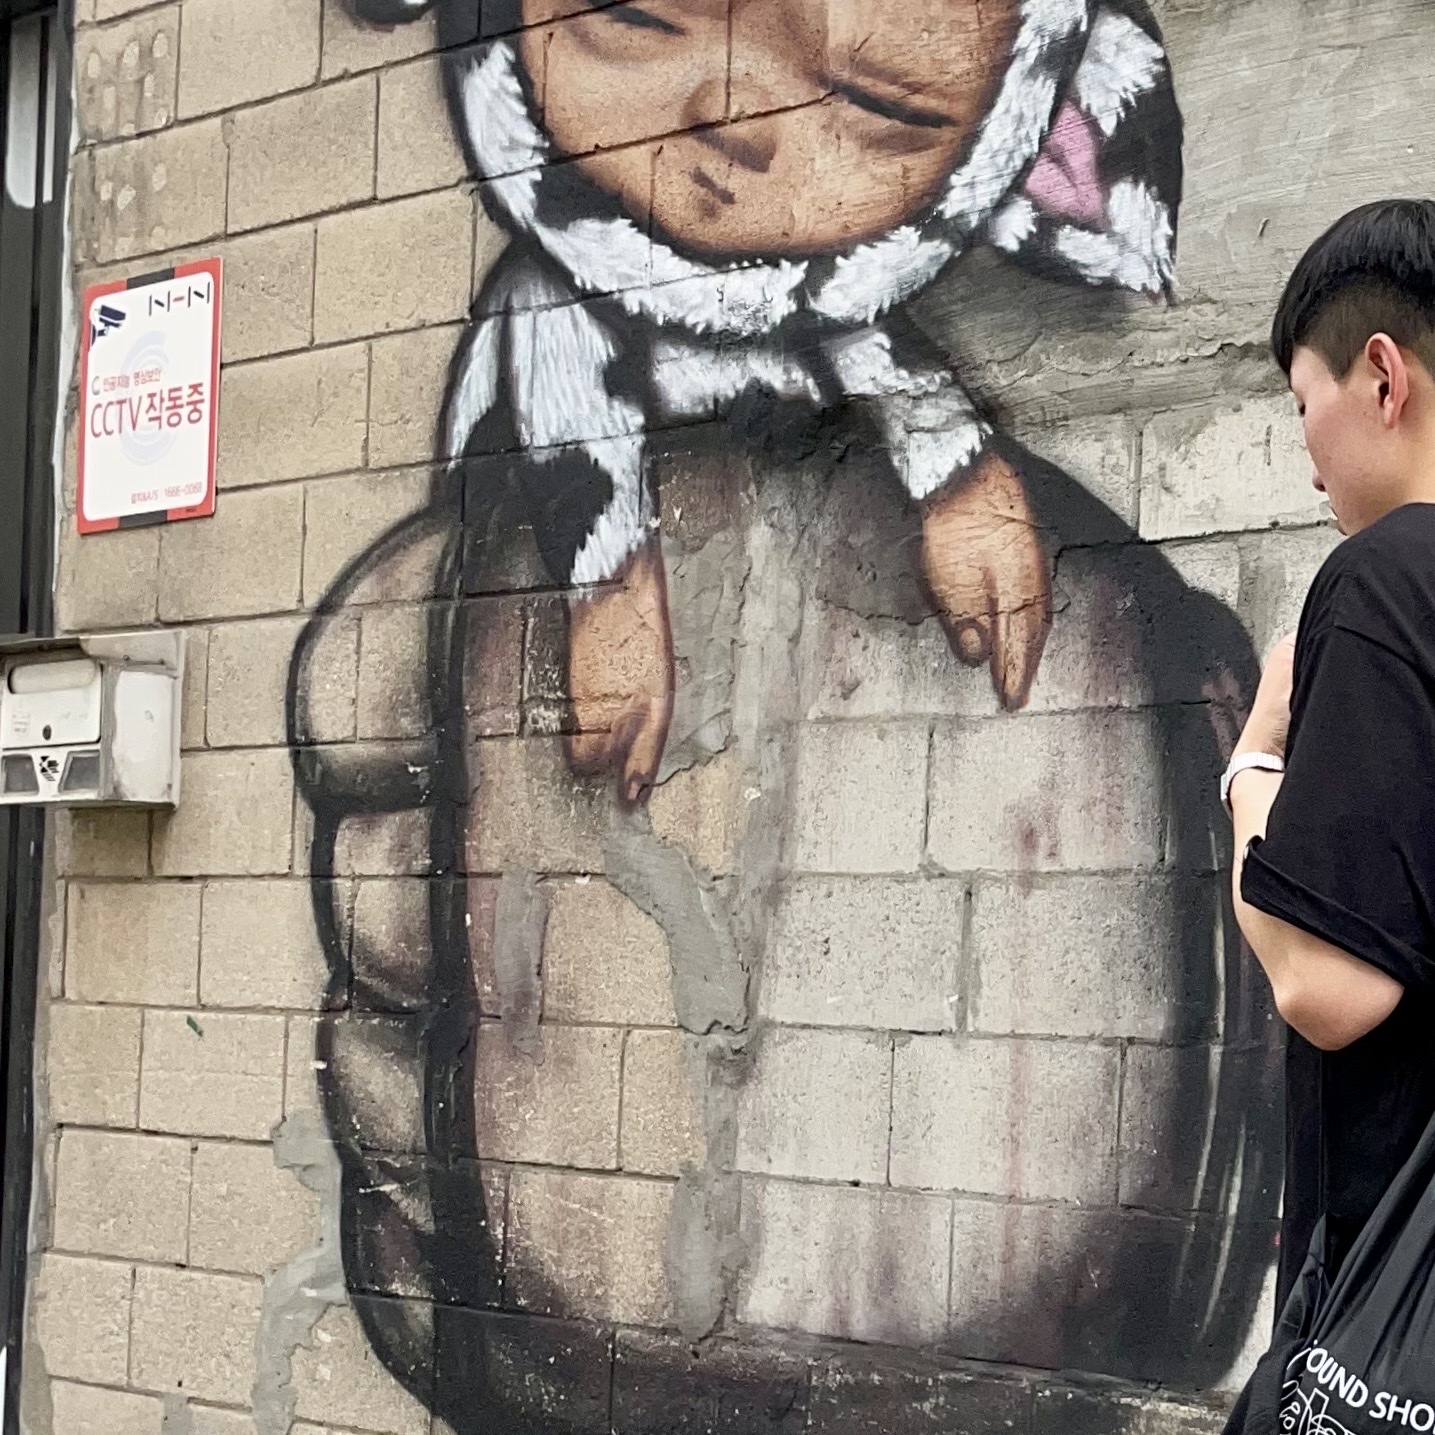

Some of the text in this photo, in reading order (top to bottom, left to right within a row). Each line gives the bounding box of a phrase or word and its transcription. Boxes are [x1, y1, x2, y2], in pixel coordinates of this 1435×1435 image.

[90, 382, 206, 438] CCTV 작동중
[1306, 1341, 1369, 1408] OUND
